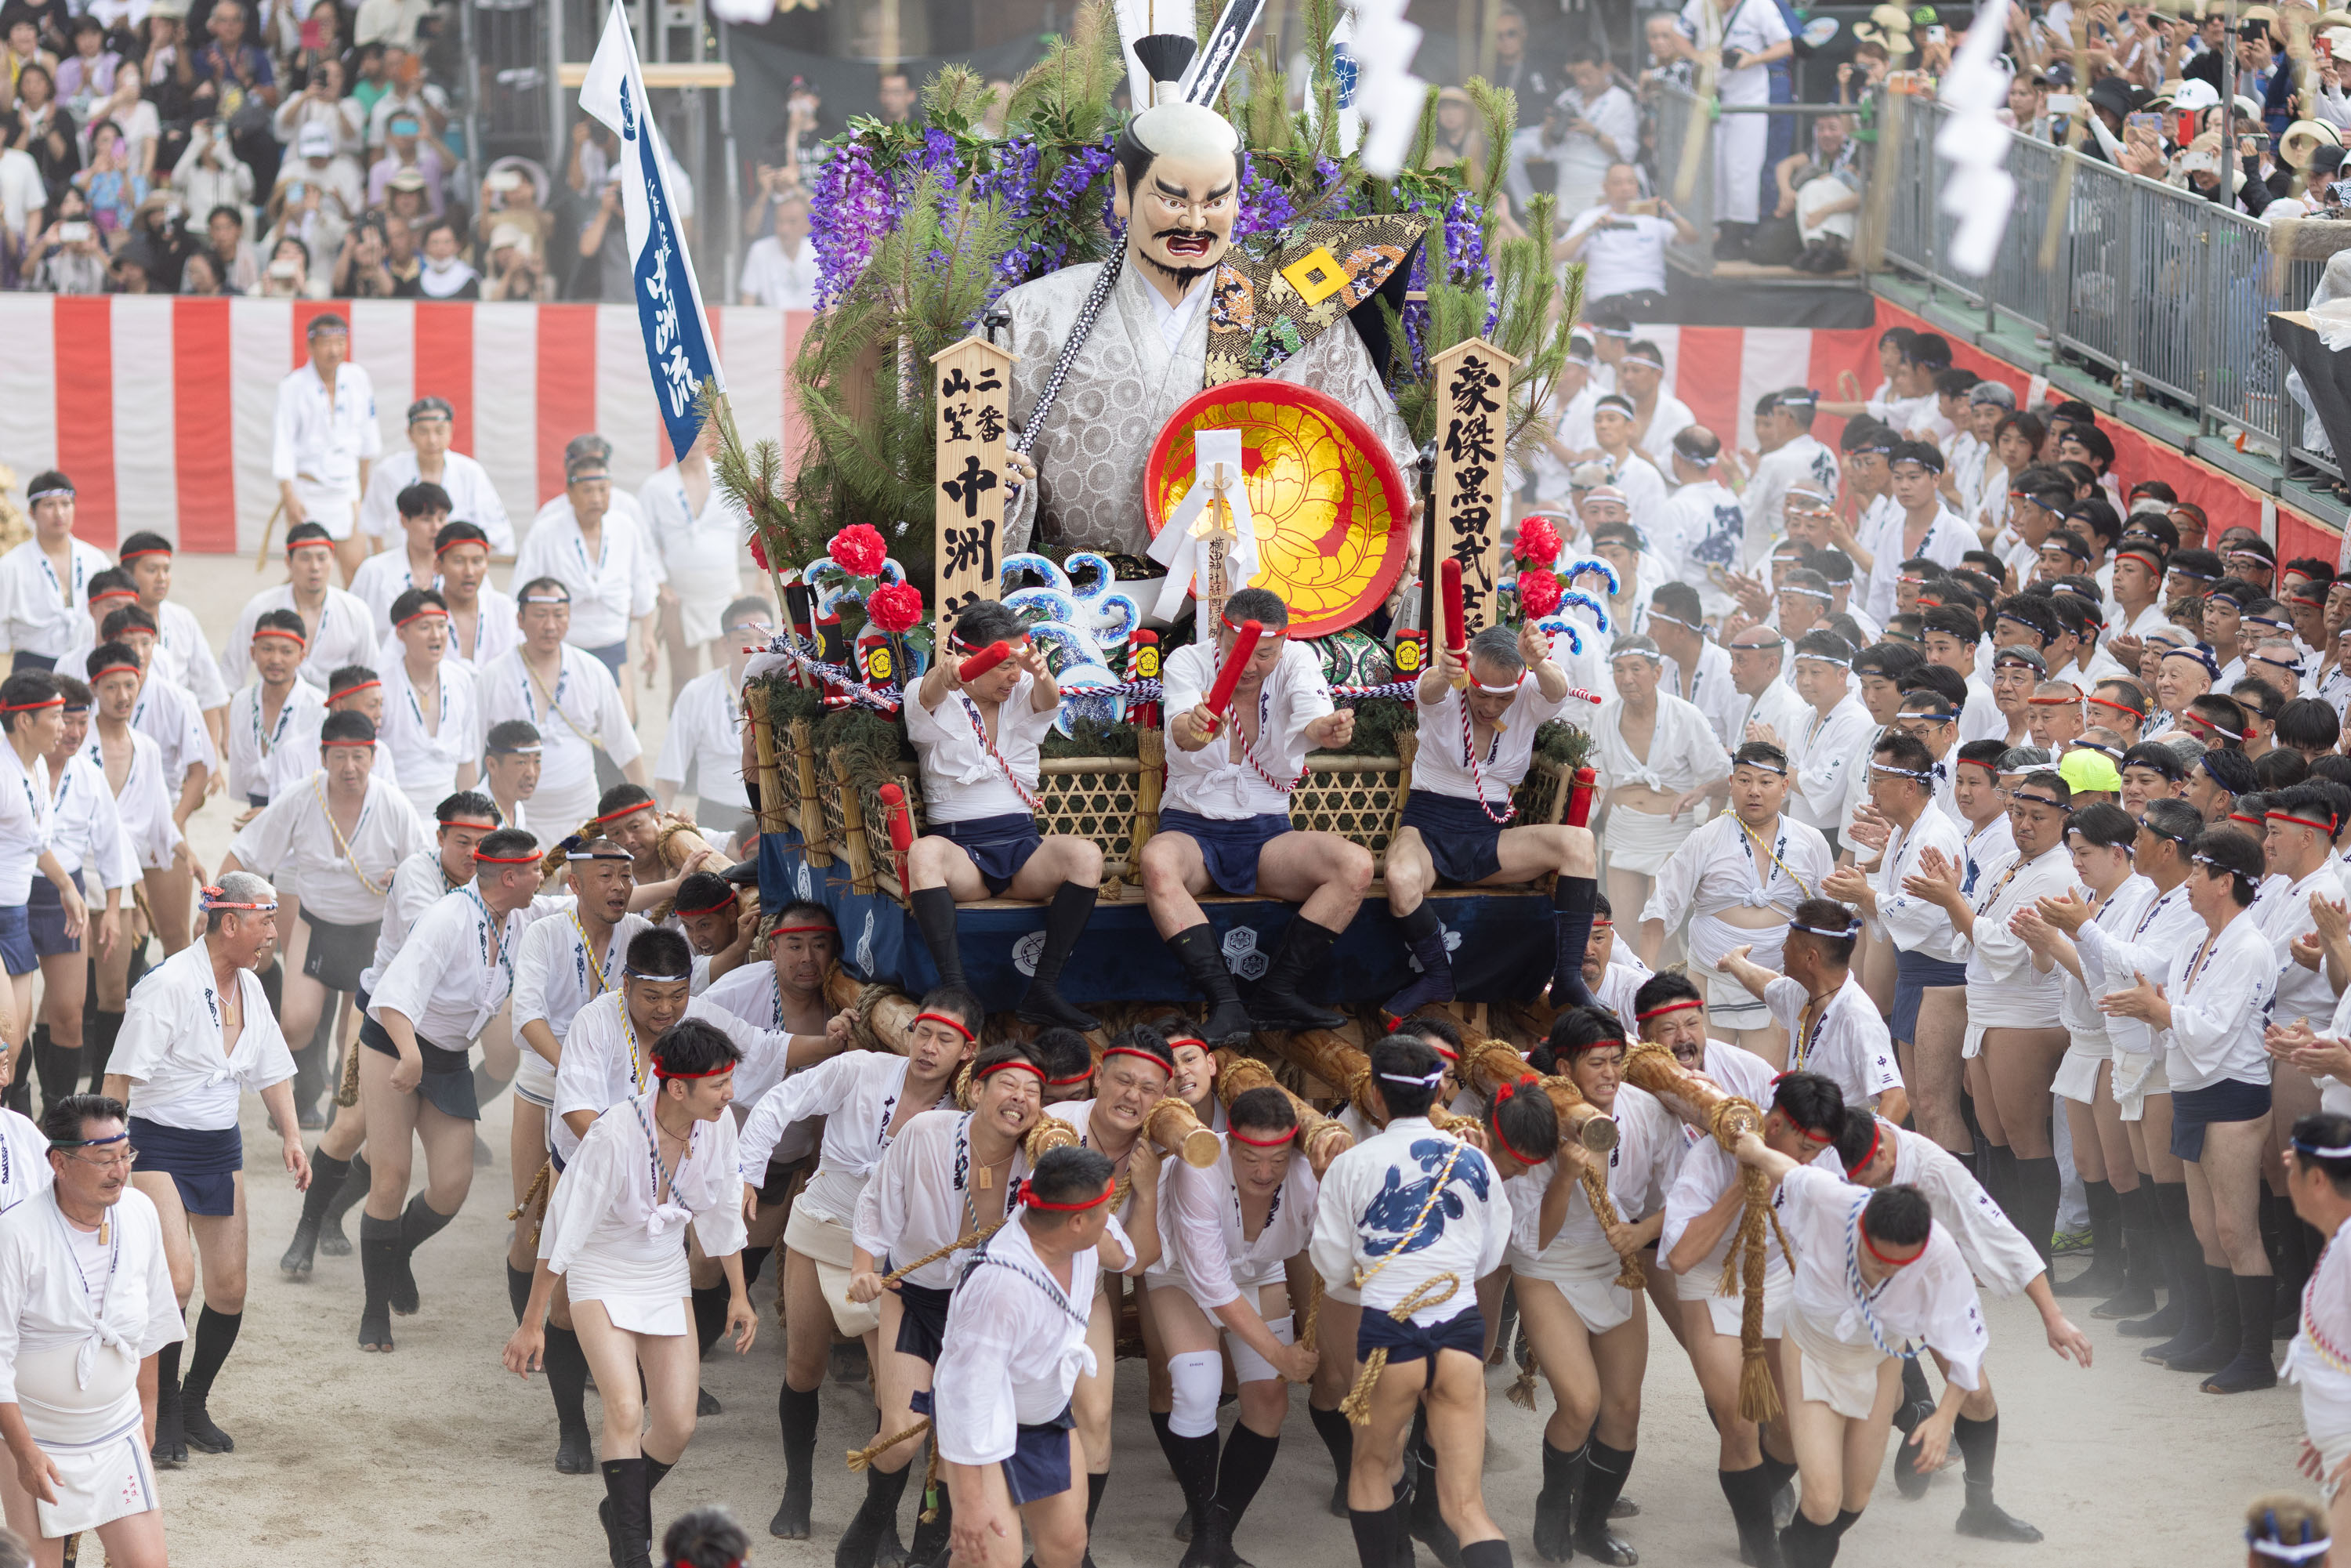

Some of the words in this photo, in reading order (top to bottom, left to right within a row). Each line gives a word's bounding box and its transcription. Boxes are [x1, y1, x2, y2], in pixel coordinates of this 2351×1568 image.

[645, 248, 703, 418] 中洲流
[942, 368, 973, 444] 山笠
[974, 368, 1005, 444] 二番
[1877, 1055, 1894, 1084] 中三
